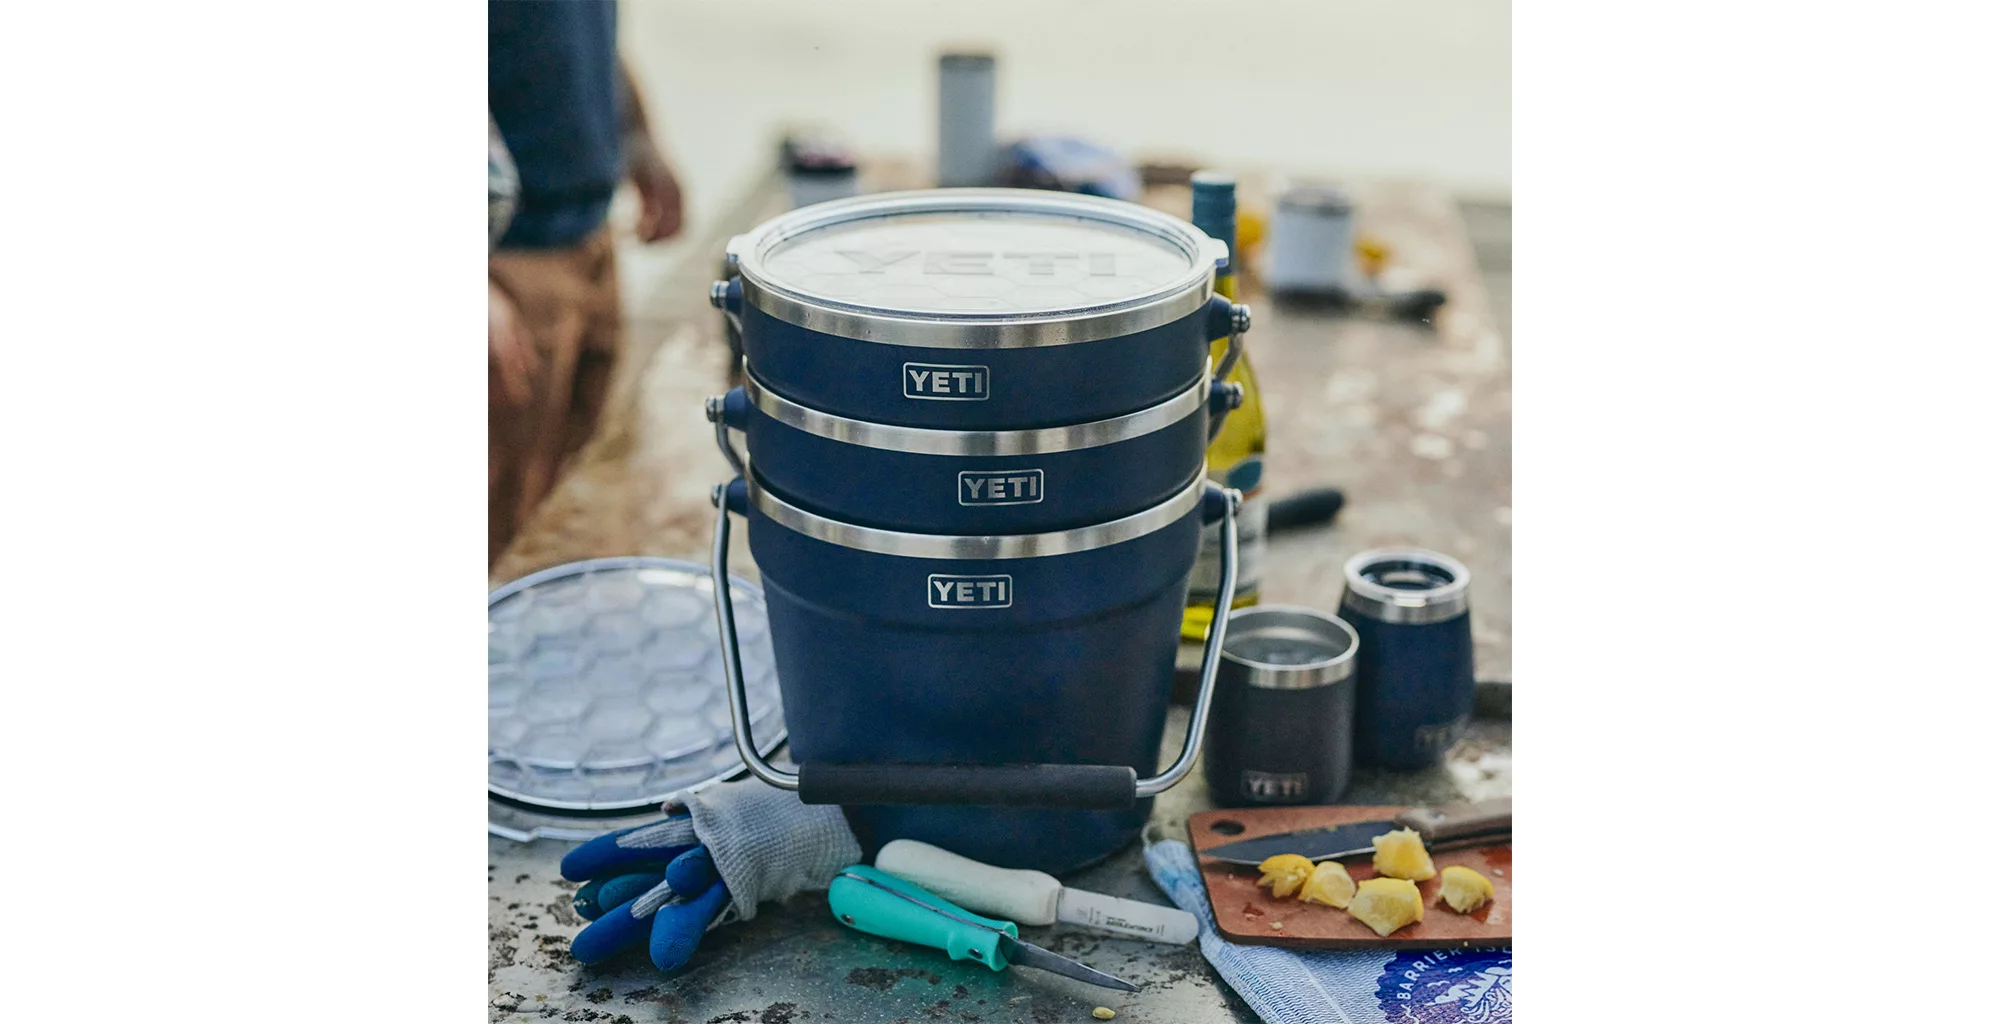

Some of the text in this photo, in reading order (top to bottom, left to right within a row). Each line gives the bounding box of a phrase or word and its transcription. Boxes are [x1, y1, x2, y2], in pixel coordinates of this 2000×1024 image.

[833, 250, 1117, 276] YETI
[908, 369, 983, 394] YETI
[964, 475, 1037, 500] YETI
[933, 581, 1006, 602] YETI
